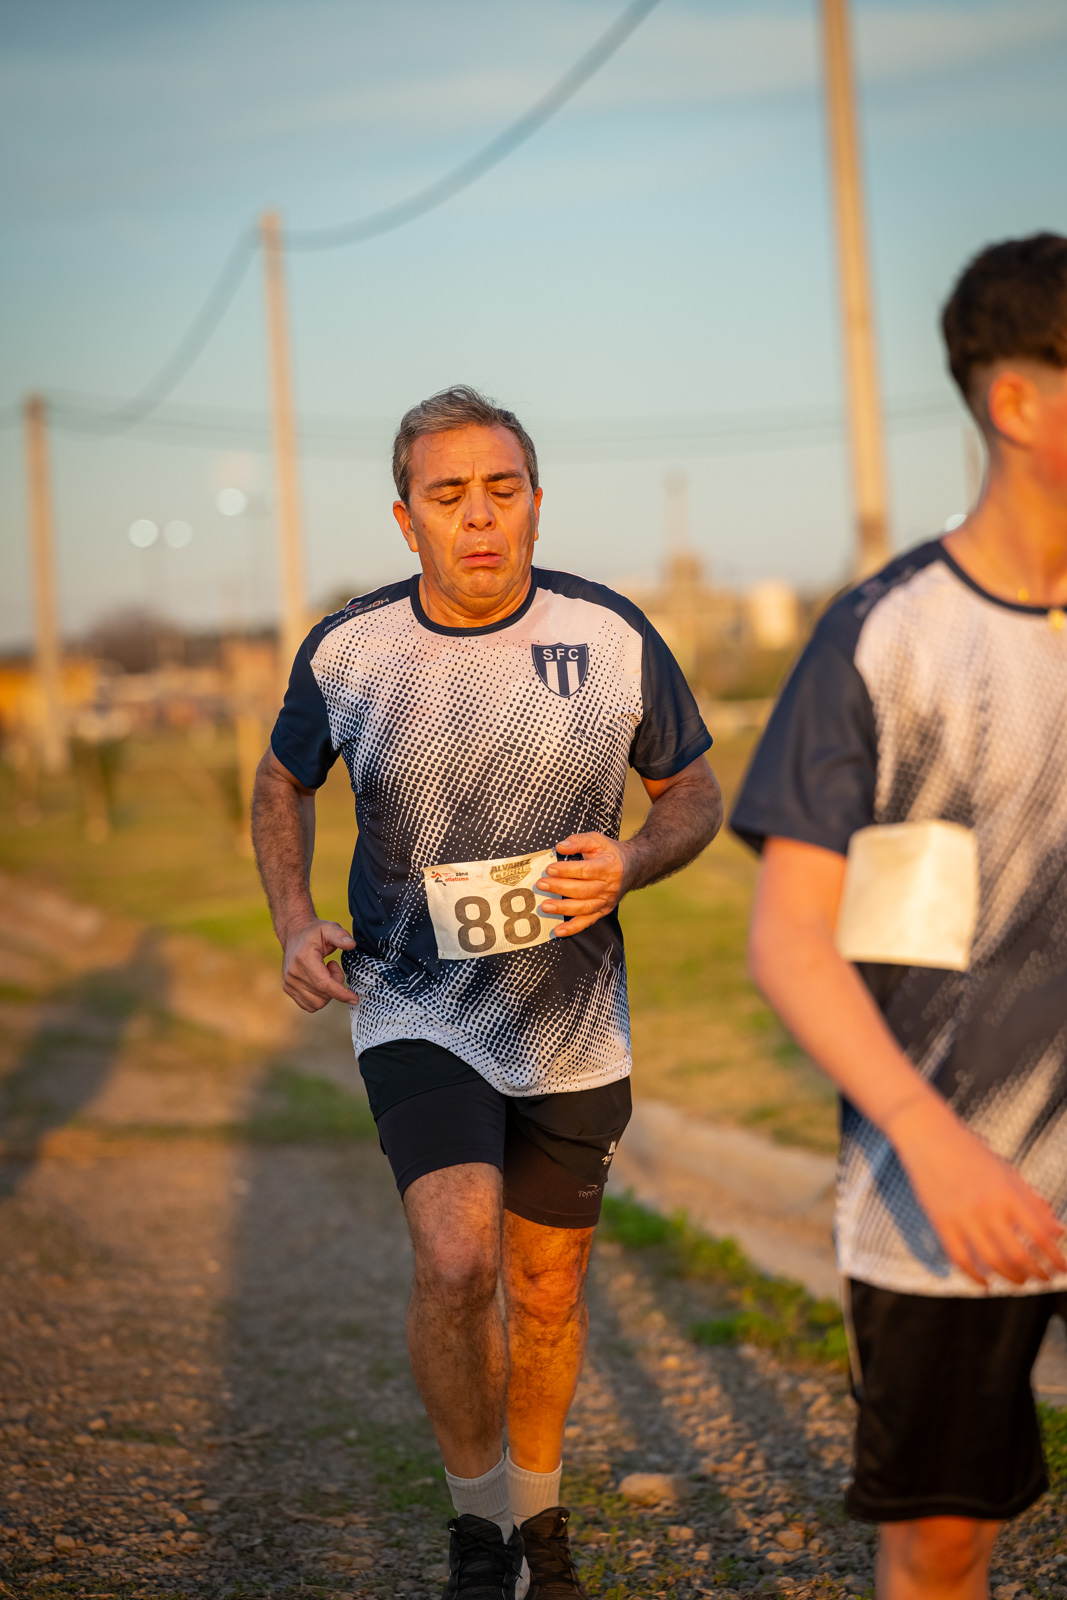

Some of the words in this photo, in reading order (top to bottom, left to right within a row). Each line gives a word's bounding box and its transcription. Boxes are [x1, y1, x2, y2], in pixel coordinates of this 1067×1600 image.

[543, 648, 579, 660] SFC
[490, 858, 531, 874] ALVAREZ
[492, 864, 531, 880] CORRE
[454, 887, 542, 954] 88
